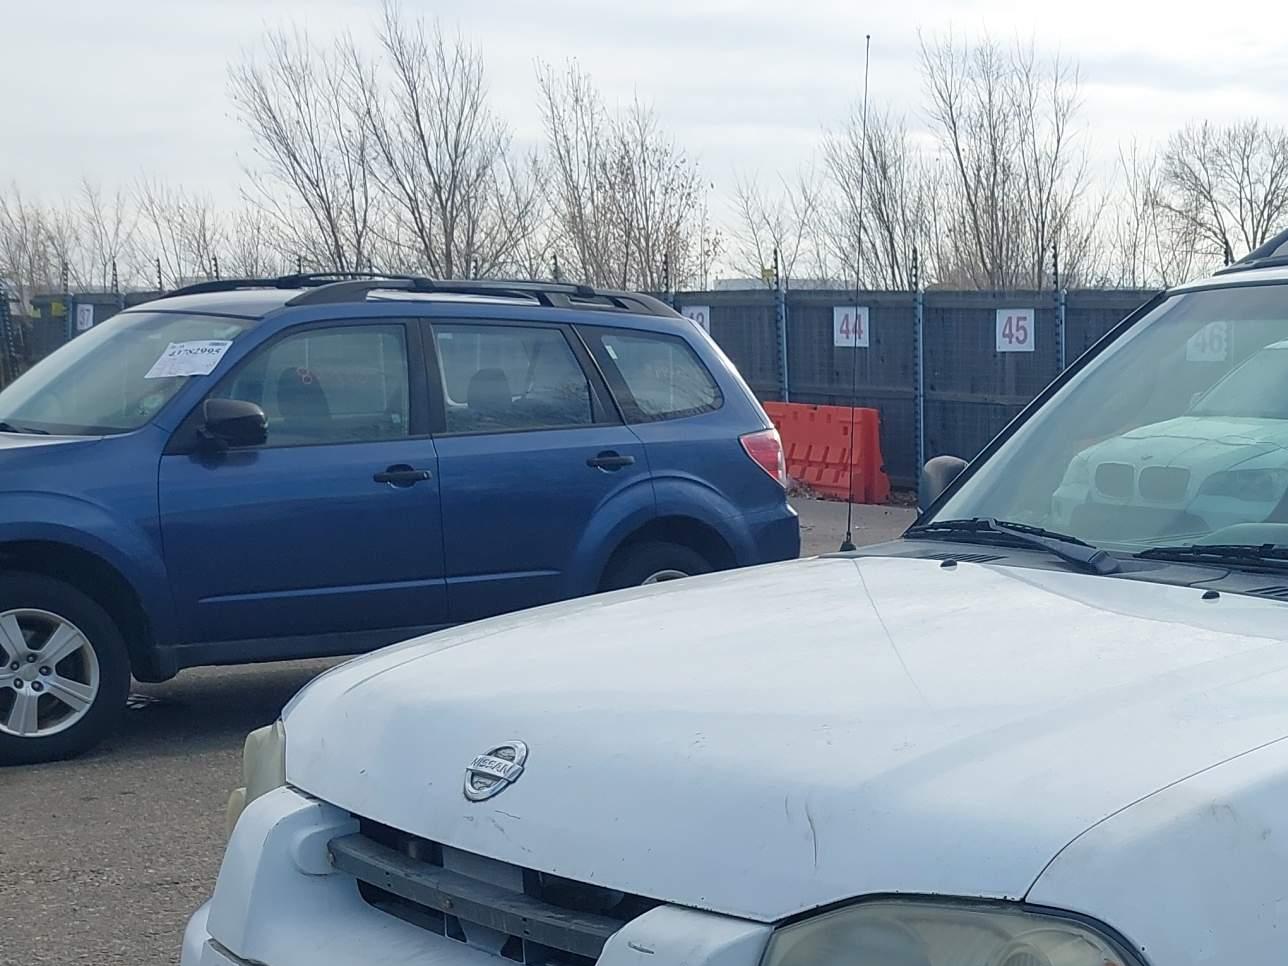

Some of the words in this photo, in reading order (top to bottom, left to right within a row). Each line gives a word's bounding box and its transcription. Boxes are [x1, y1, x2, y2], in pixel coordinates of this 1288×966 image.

[839, 313, 864, 340] 44
[1002, 315, 1028, 345] 45
[470, 757, 513, 775] NISSAN
